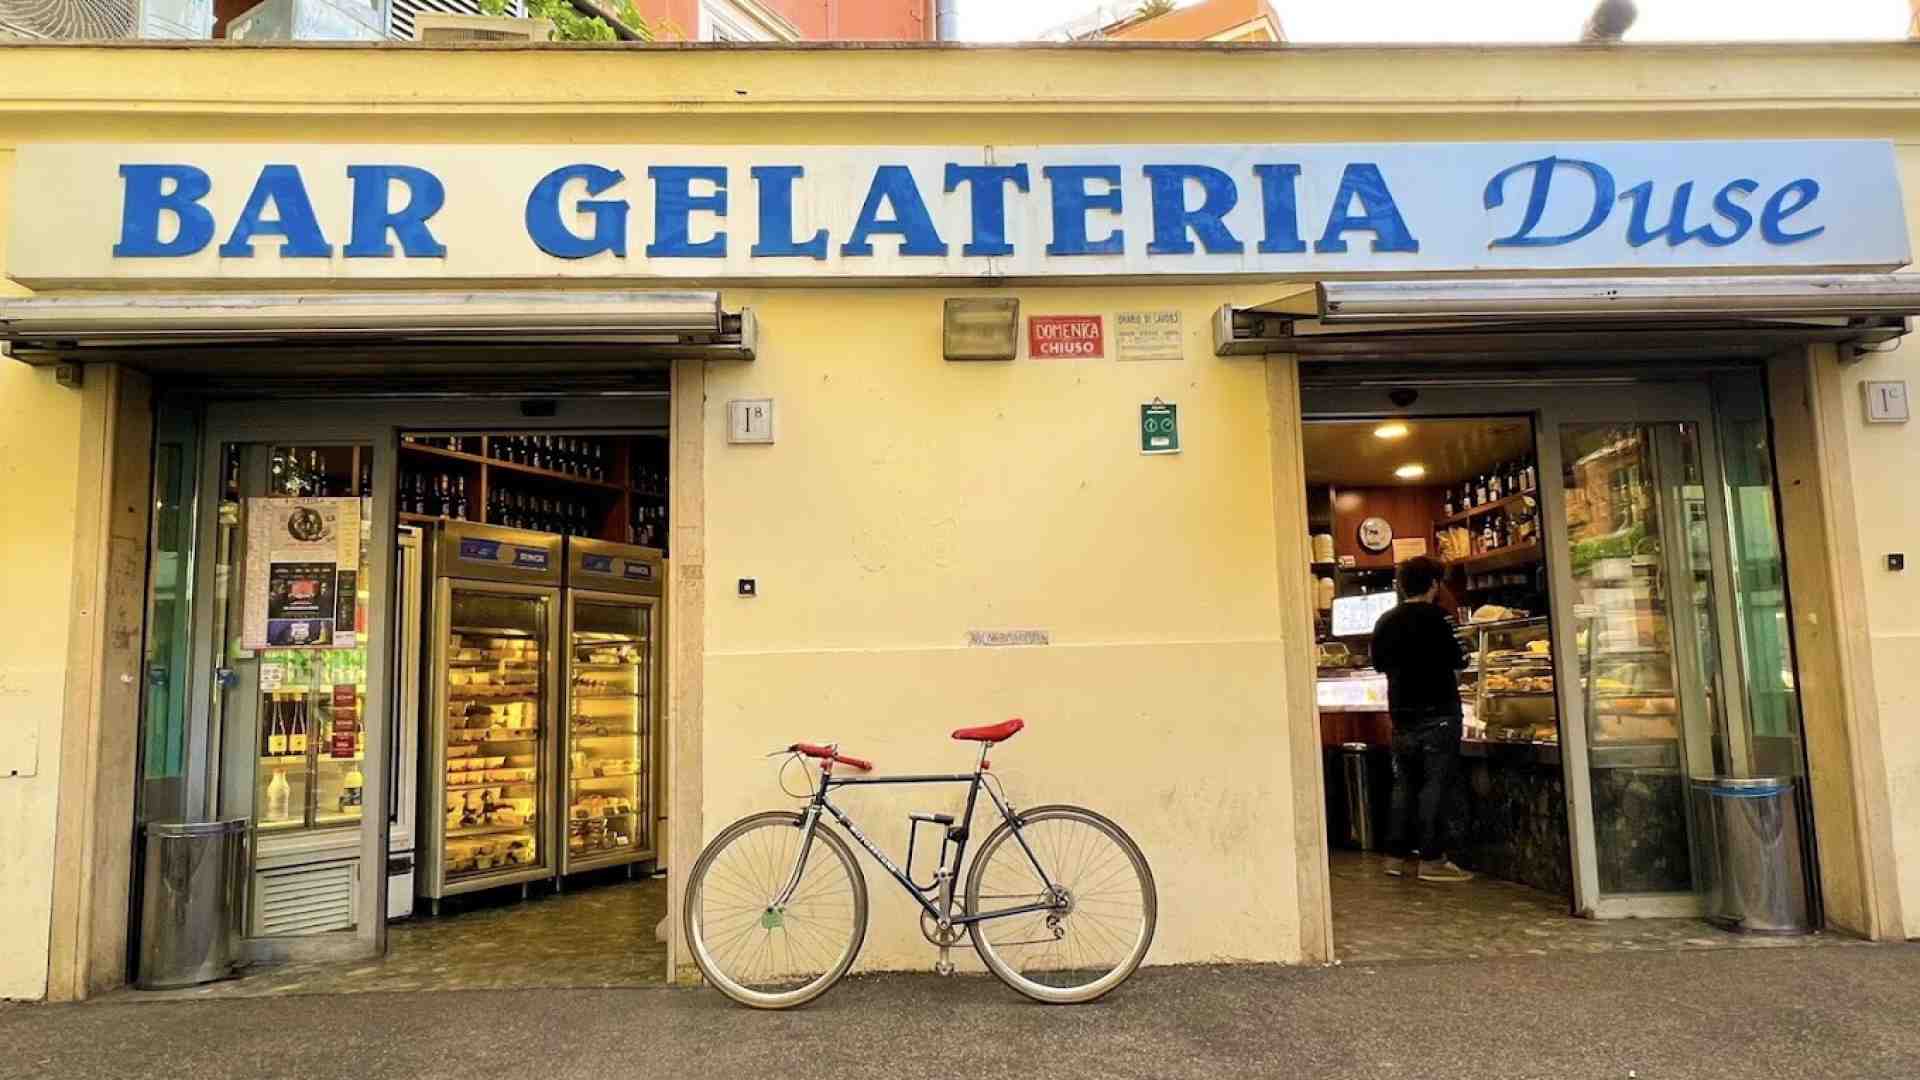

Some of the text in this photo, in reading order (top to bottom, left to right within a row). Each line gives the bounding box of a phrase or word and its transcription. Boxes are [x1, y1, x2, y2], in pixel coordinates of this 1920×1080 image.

[113, 154, 1825, 258] BAR GELATERIA Duse
[1040, 341, 1094, 354] CHIUSO
